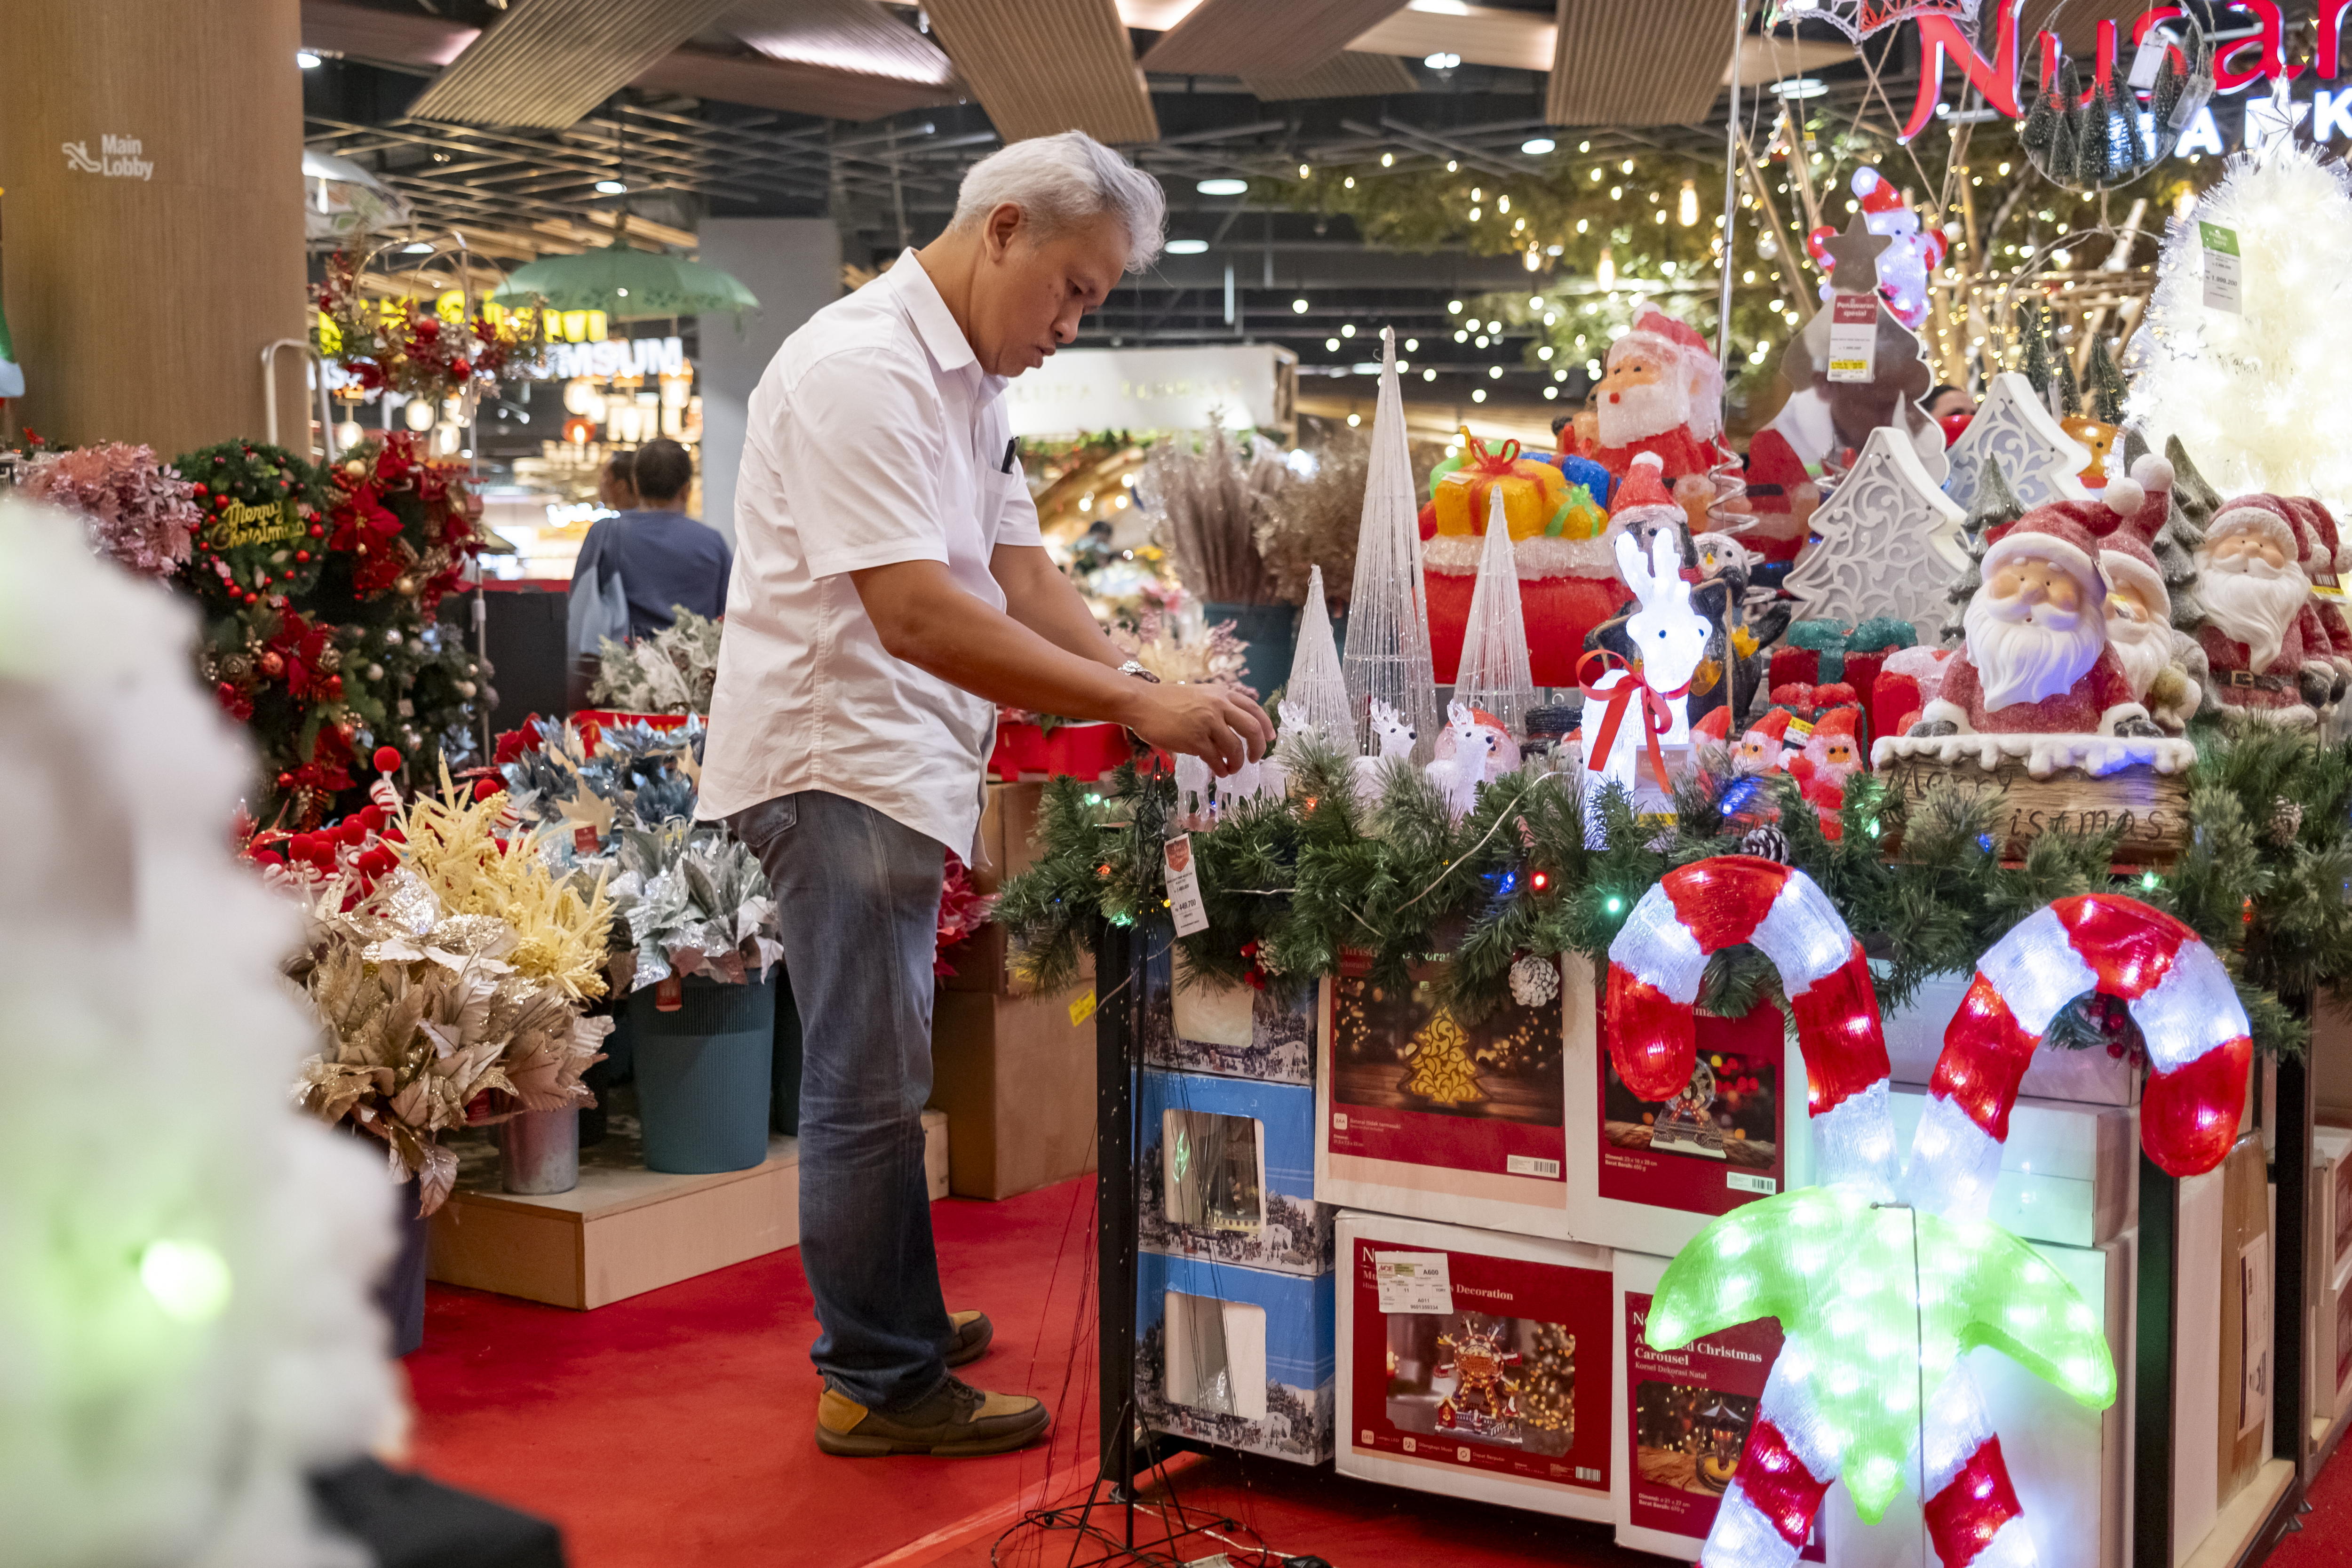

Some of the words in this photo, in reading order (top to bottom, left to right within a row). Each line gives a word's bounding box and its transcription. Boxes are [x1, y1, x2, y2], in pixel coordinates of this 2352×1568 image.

[102, 134, 142, 155] Main
[103, 155, 154, 181] Lobby
[222, 497, 284, 527] Merry
[1179, 899, 1196, 911] 449.700
[1456, 1283, 1513, 1301] Decoration
[1635, 1347, 1689, 1366] Carousel
[1697, 1342, 1762, 1363] Christmas
[1636, 1361, 1656, 1371] Korsel
[1658, 1365, 1687, 1376] Dekorasi
[1689, 1370, 1707, 1379] Natal
